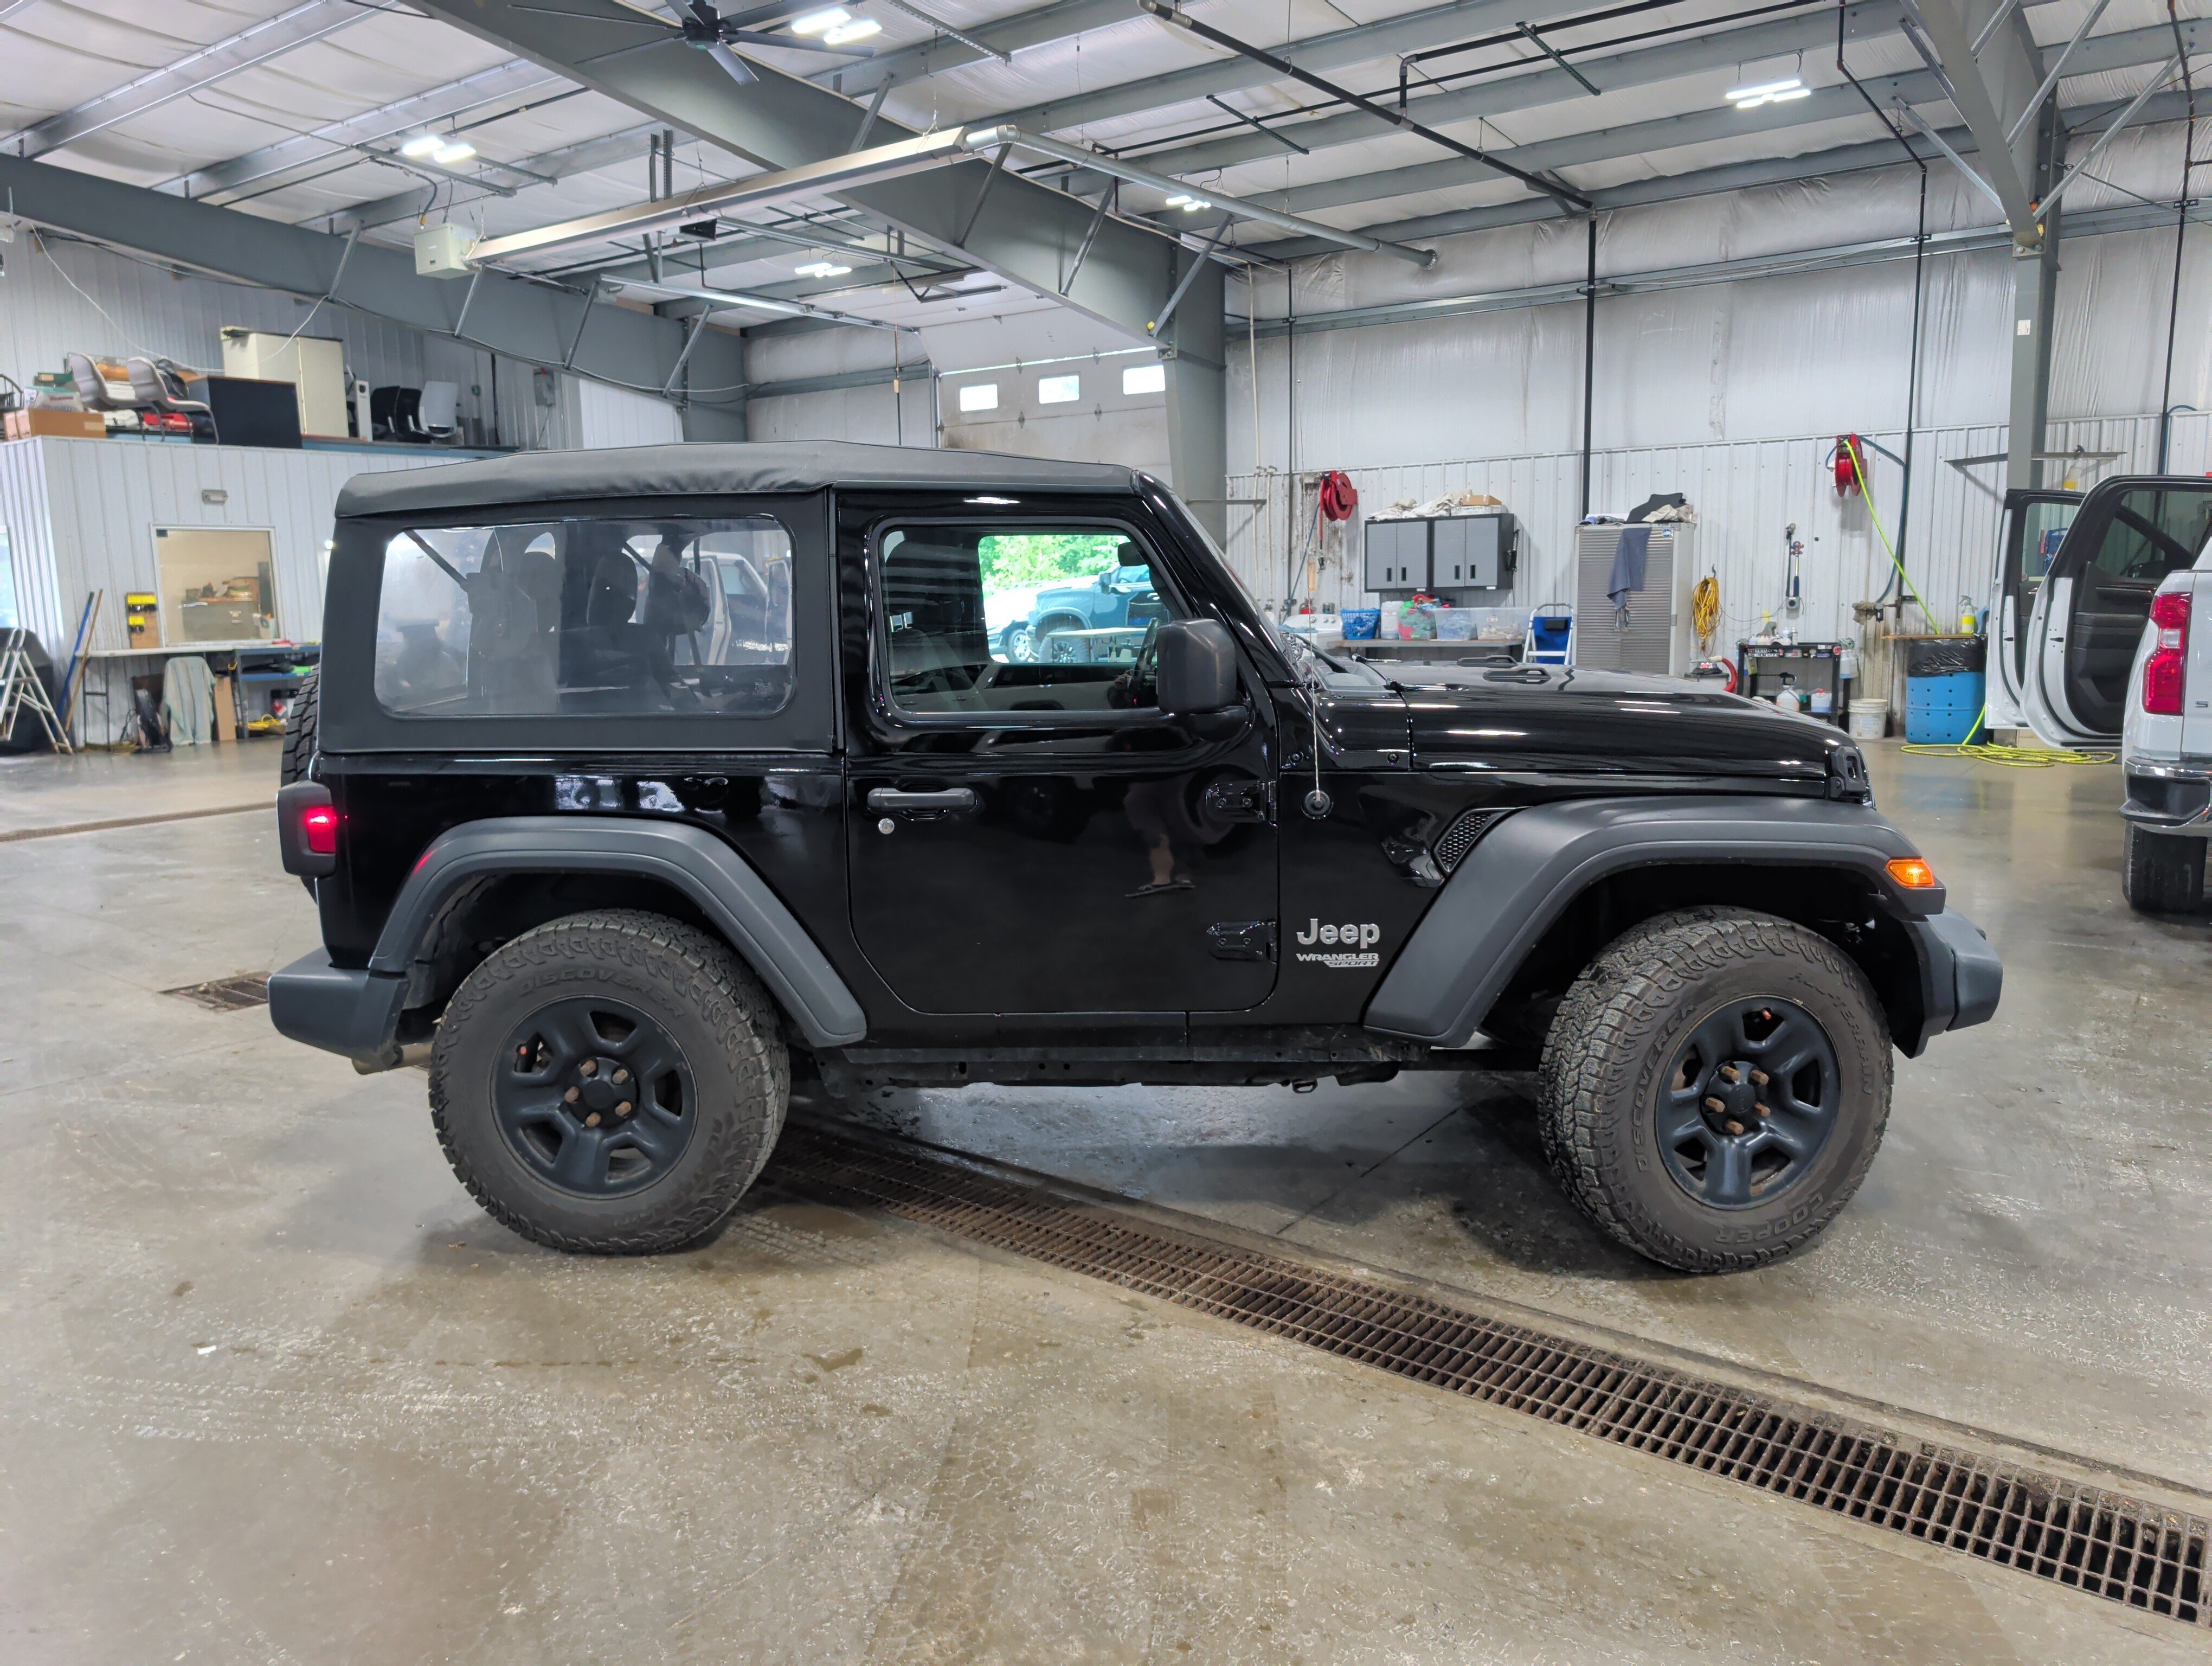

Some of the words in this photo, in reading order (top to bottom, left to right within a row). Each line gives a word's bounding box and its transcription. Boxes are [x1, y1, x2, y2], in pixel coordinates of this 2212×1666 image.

[1296, 918, 1380, 949] Jeep
[1296, 953, 1379, 961] WRANGLER
[518, 968, 684, 1018] DISCOVERER
[1632, 1003, 1698, 1173] DISCOVERER
[1714, 1192, 1823, 1244] COOPER
